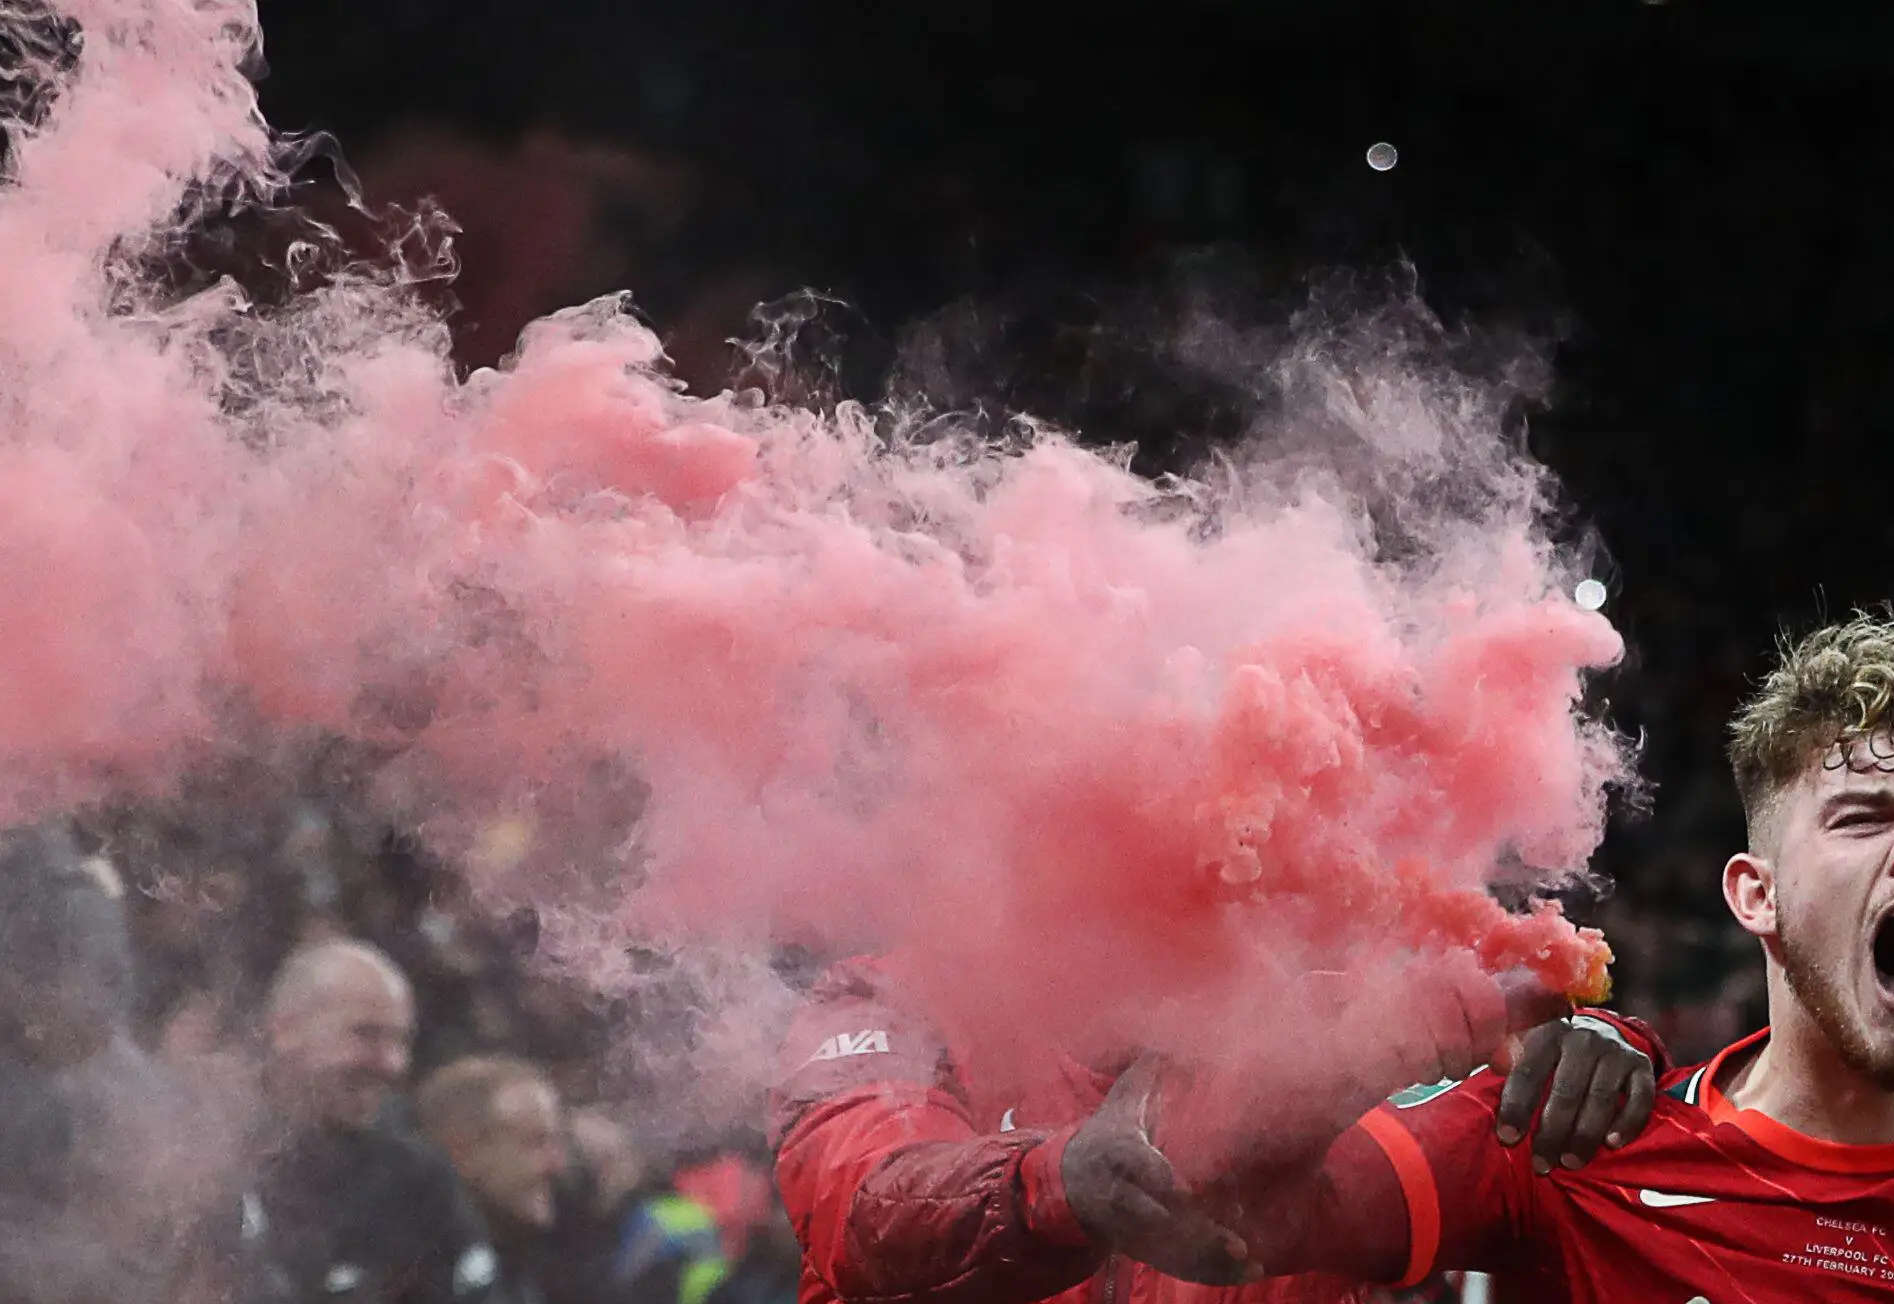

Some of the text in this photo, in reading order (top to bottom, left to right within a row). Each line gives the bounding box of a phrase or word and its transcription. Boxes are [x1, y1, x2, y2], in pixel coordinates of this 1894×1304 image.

[1815, 1216, 1887, 1237] CHELSEA FC
[1782, 1253, 1812, 1267] 27TH
[1816, 1259, 1876, 1277] FEBRUARY
[1805, 1243, 1889, 1265] LIVERPOOL FC
